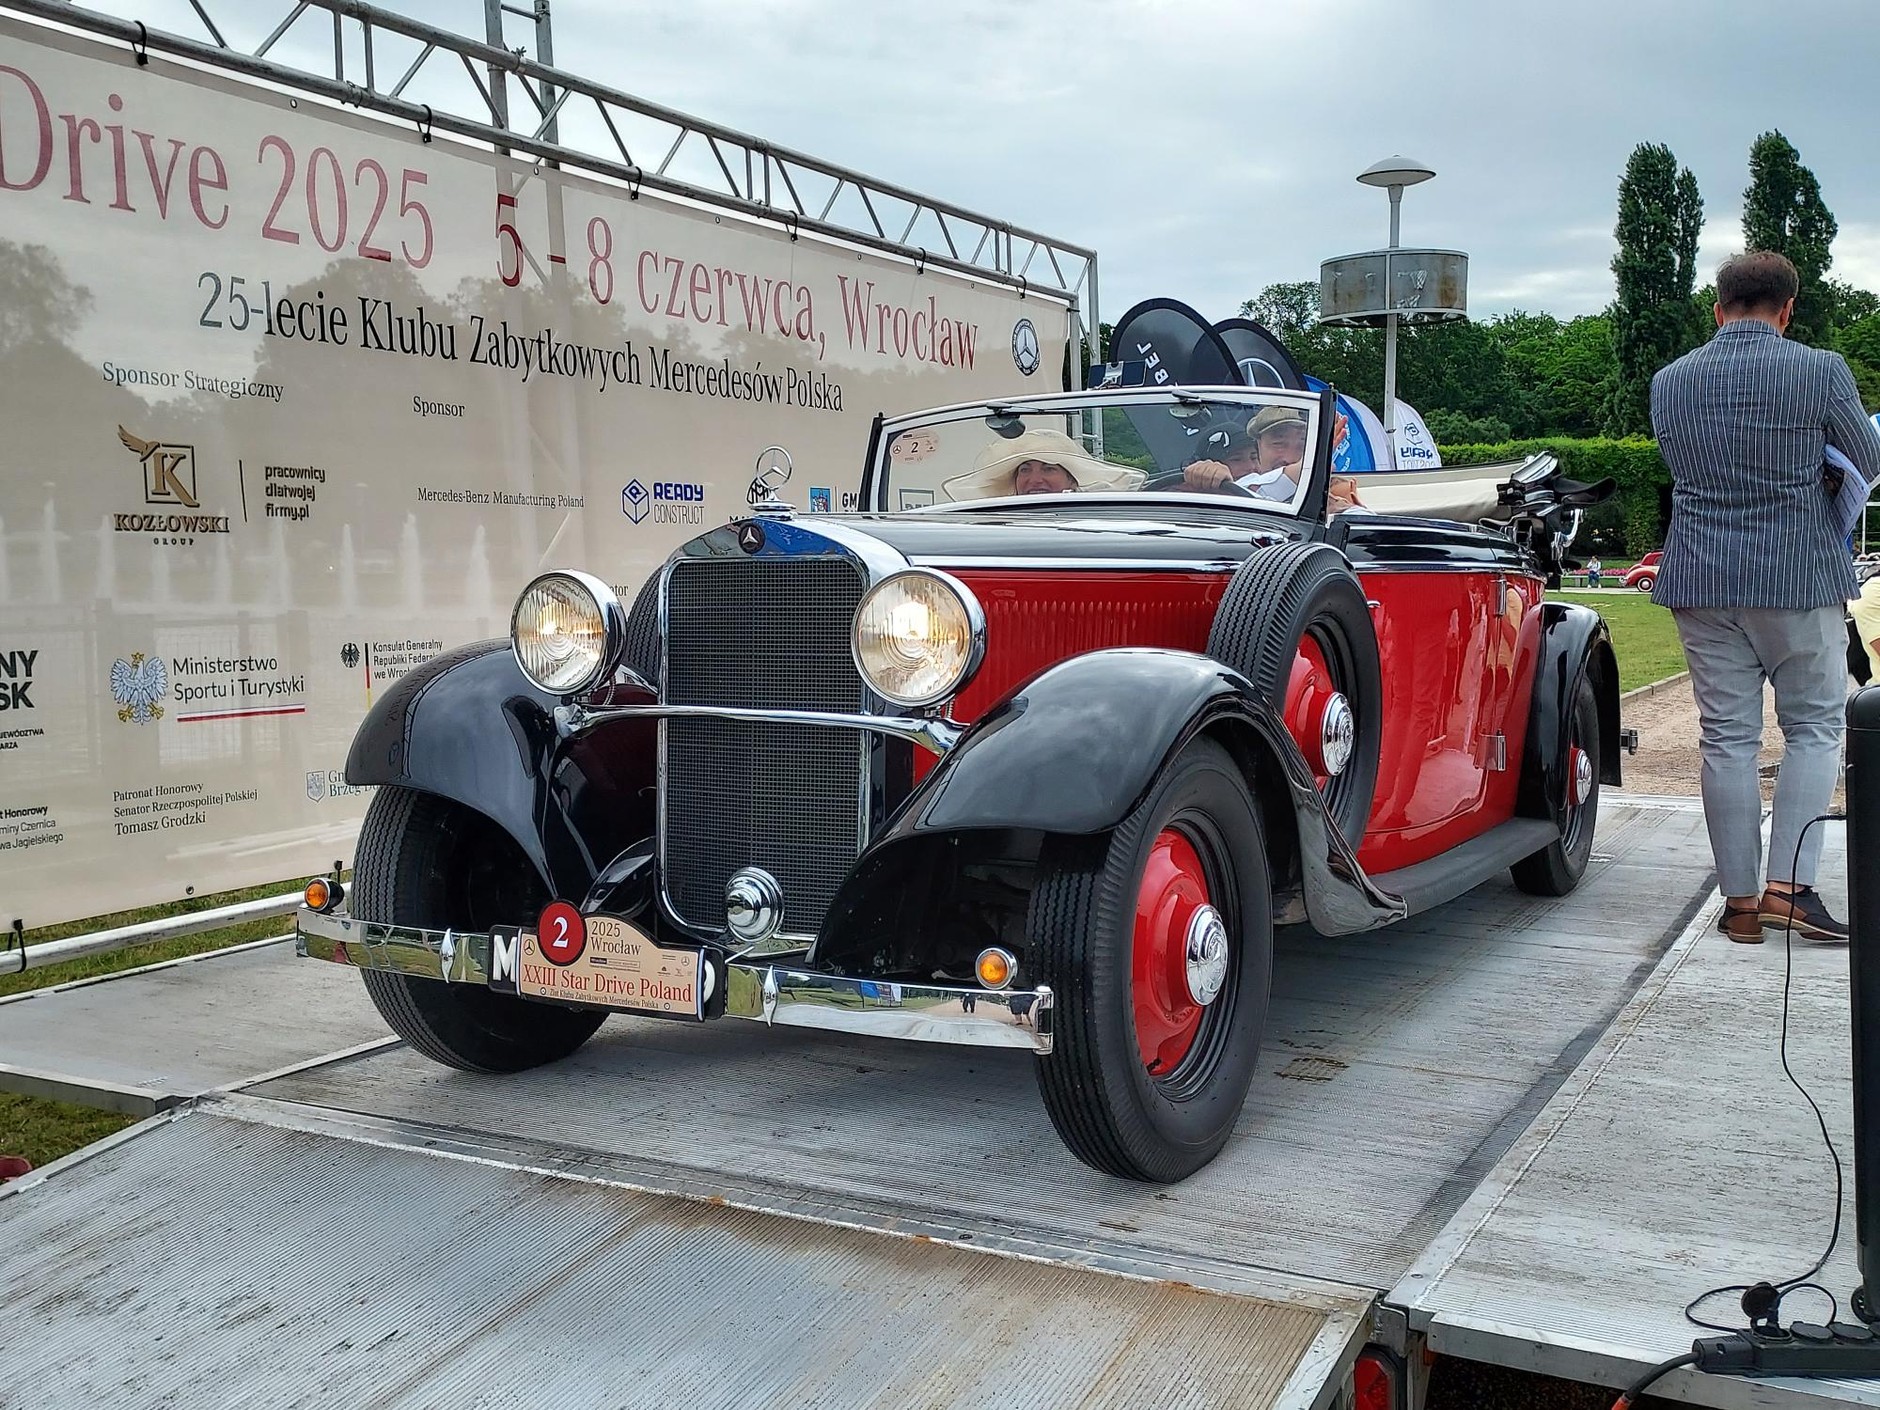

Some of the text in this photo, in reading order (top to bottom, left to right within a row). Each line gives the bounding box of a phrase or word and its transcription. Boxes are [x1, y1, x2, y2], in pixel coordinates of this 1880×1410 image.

[0, 64, 230, 230] Drive
[258, 135, 434, 269] 2025
[496, 192, 524, 287] 5
[586, 215, 614, 306] 8
[636, 249, 827, 362] czerwca,
[838, 275, 979, 371] Wrocław
[197, 270, 844, 412] 25-lecie Klubu Zabytkowych Mercedesów Polska
[102, 361, 285, 403] Sponsor Strategiczny
[413, 395, 465, 417] Sponsor
[911, 441, 919, 453] 2
[264, 465, 326, 482] pracownicy
[417, 487, 584, 509] Mercedes-Benz Manufacturing Poland
[653, 482, 704, 502] READY
[264, 503, 310, 522] firmy.pl
[653, 504, 704, 525] CONSTRUCT
[113, 513, 230, 534] KOZŁOWSKI
[153, 537, 195, 546] GROUP
[373, 639, 443, 653] Konsulat Generalny
[173, 655, 278, 676] Ministerstwo
[373, 654, 407, 667] Republiki
[174, 675, 304, 704] Sportu i Turystyki
[113, 782, 204, 802] Patronat Honorowy
[4, 805, 48, 819] Honorowy
[114, 788, 258, 818] Senator Rzeczpospolitej Polskiej
[20, 818, 56, 832] Czernica
[114, 811, 206, 836] Tomasz Grodzki
[12, 832, 64, 849] Jagielskiego
[552, 916, 570, 948] 2
[591, 920, 621, 938] 2025
[590, 937, 641, 955] Wrocław
[523, 963, 557, 987] XXIII
[560, 969, 591, 992] Star
[594, 973, 635, 996] Drive
[639, 978, 693, 1003] Poland
